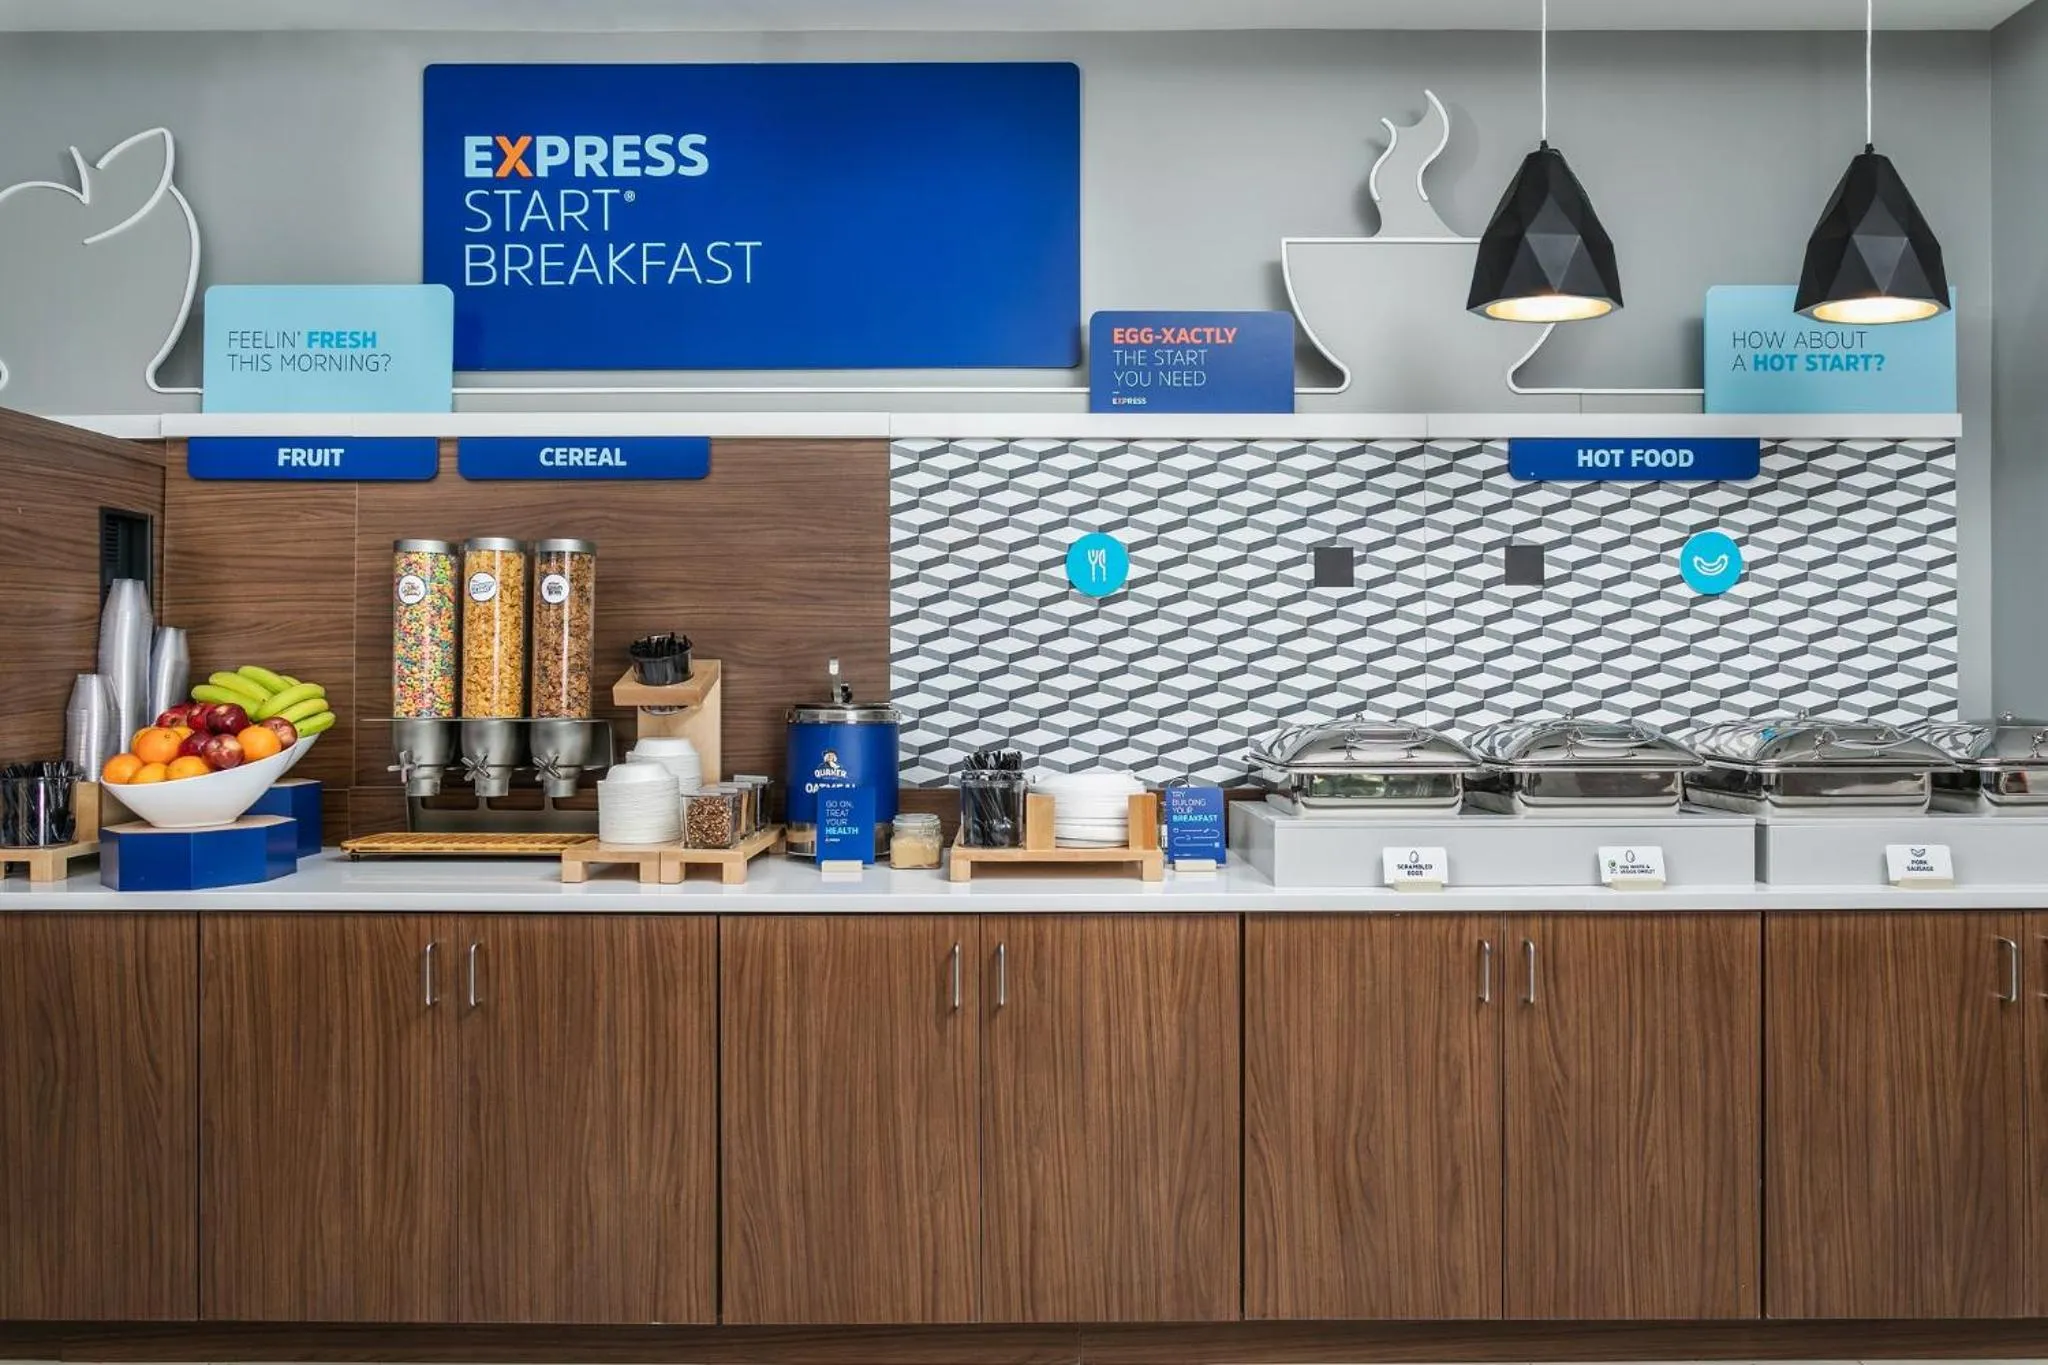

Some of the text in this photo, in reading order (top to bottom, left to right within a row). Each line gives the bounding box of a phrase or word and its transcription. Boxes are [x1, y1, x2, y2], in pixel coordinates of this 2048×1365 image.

[464, 134, 709, 178] EXPRESS
[464, 241, 762, 286] BREAKFAST
[307, 331, 377, 349] FRESH
[1113, 327, 1237, 344] EGG-XACTLY
[1732, 331, 1867, 349] HOW ABOUT
[227, 354, 392, 372] THIS MORNING?
[1113, 350, 1207, 366] THE START
[1732, 354, 1885, 371] A HOT START?
[1113, 371, 1206, 387] YOU NEED
[1112, 397, 1147, 405] EXPRESS
[278, 448, 344, 467] FRUIT
[540, 447, 627, 466] CEREAL
[1577, 449, 1694, 468] HOT FOOD
[814, 769, 847, 778] QUAKER
[826, 800, 837, 808] GO
[826, 809, 849, 817] TREAT
[825, 827, 858, 835] HEALTH
